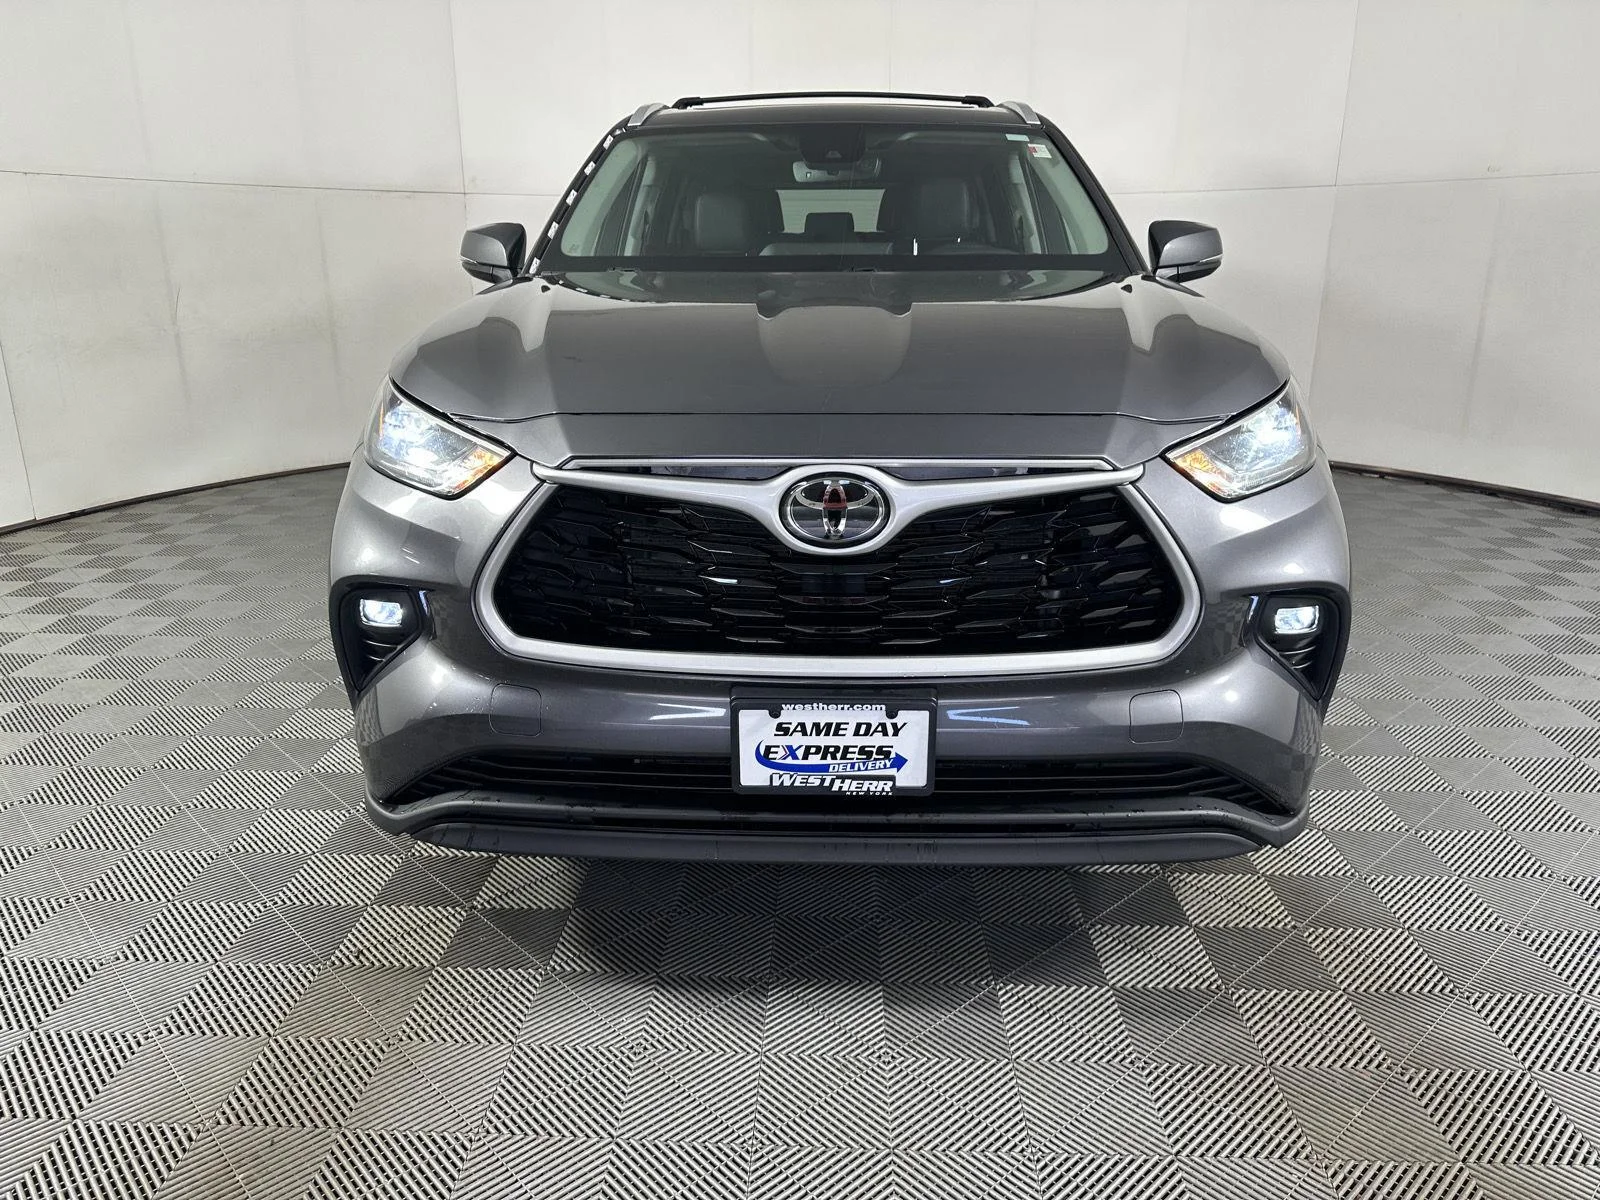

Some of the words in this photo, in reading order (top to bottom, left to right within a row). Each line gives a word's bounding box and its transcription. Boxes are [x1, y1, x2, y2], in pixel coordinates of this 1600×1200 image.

[781, 702, 886, 712] westherr.com
[774, 721, 850, 737] SAME
[853, 721, 909, 737] DAY
[763, 744, 894, 761] EXPRESS
[828, 758, 894, 773] DELIVERY
